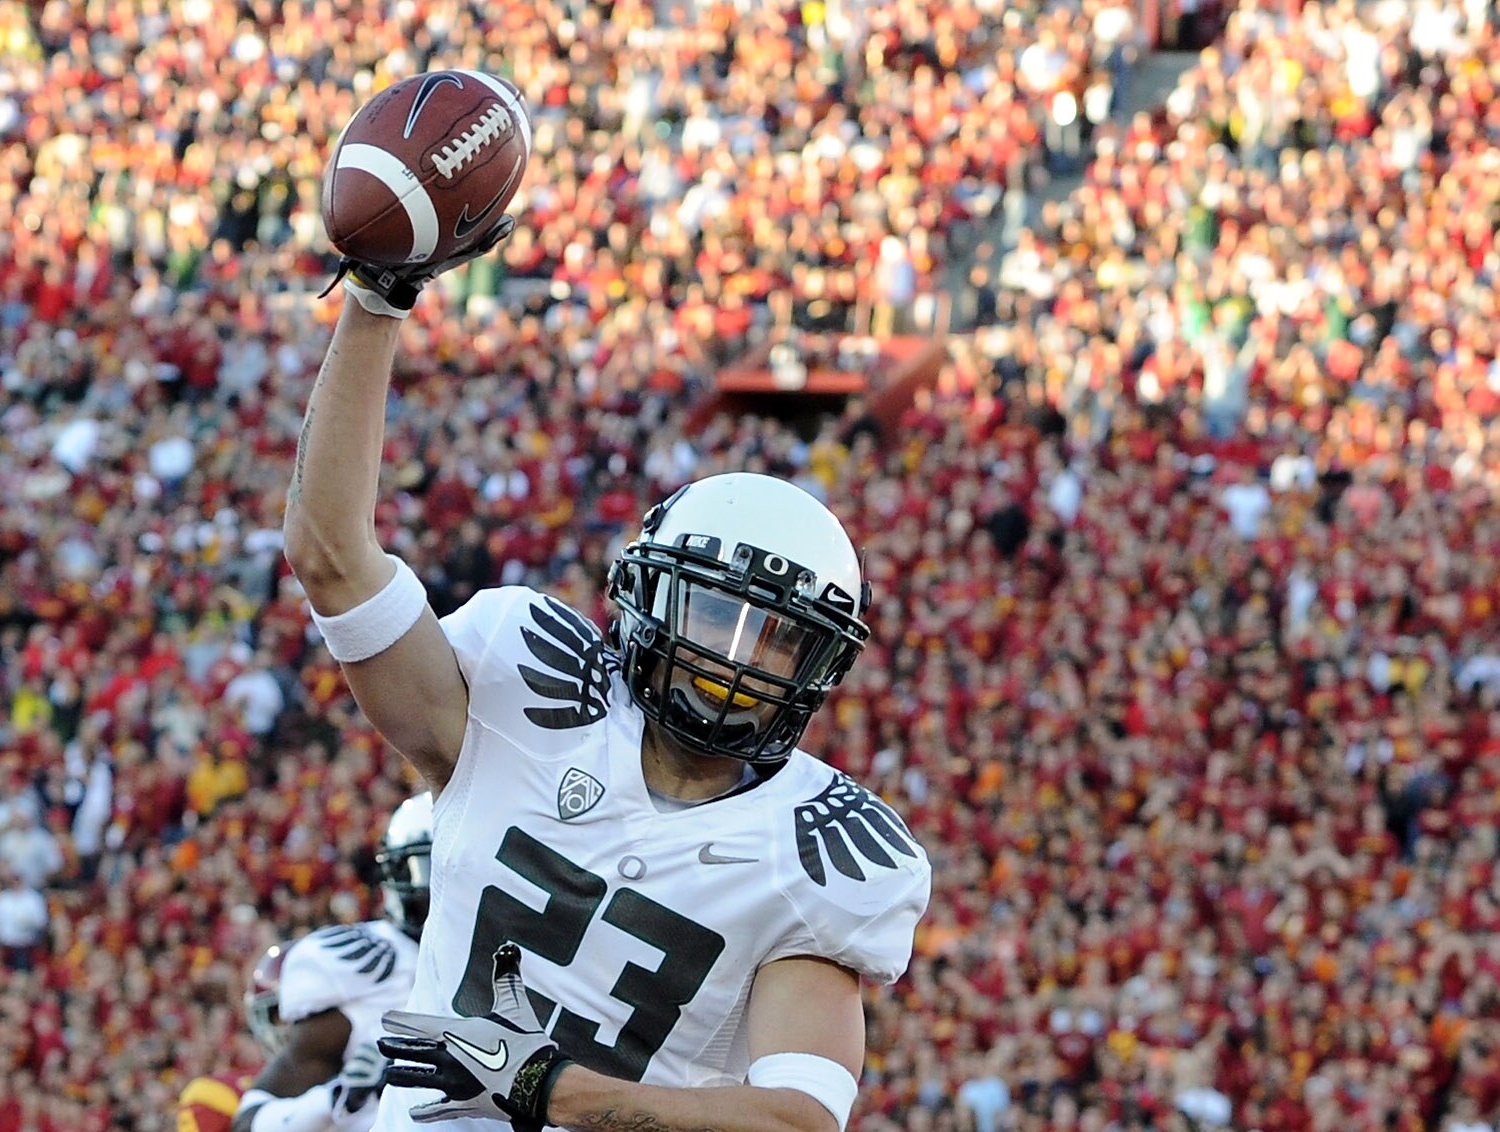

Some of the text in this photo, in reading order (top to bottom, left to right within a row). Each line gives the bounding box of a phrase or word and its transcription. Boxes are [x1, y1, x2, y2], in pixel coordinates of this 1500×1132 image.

[763, 553, 790, 576] O
[617, 854, 648, 881] O
[451, 824, 726, 1083] 23
